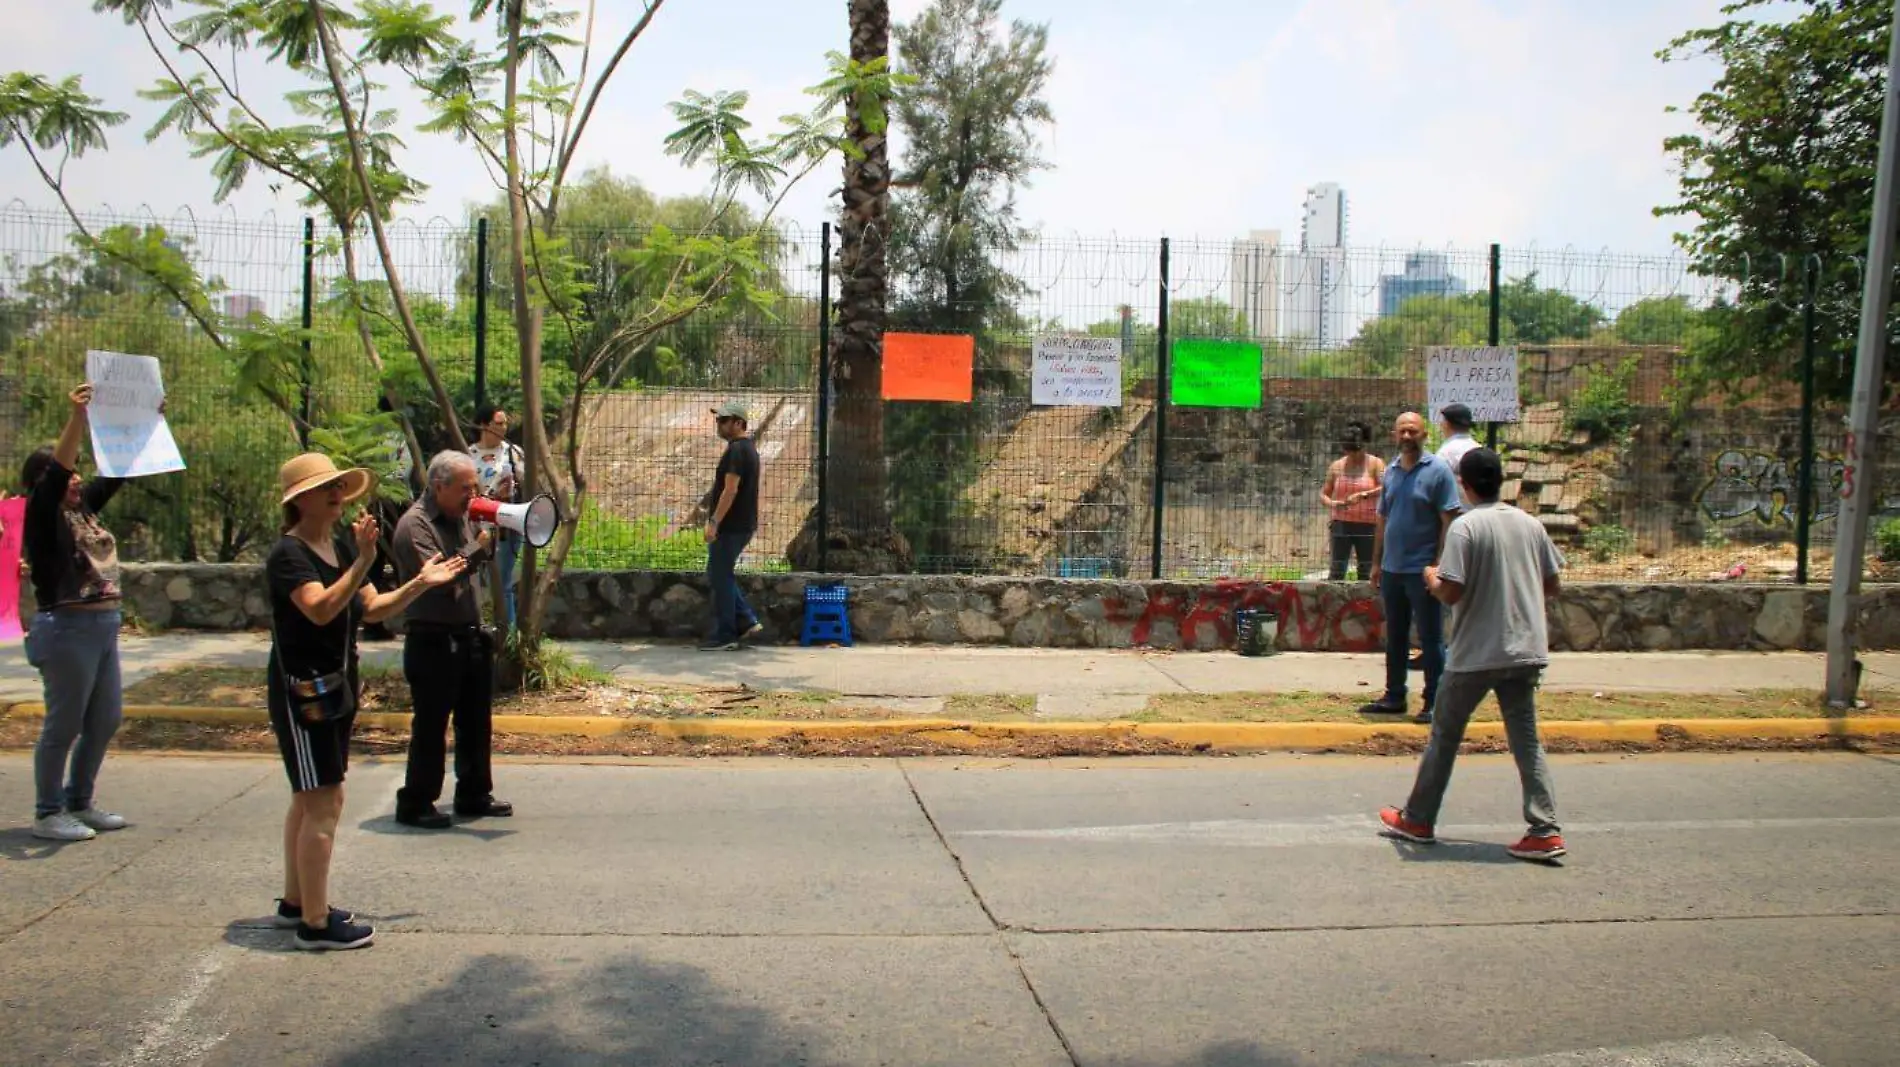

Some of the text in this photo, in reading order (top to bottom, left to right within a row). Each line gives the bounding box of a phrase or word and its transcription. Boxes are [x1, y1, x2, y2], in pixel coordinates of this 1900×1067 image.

[1443, 367, 1461, 383] LA
[1467, 367, 1513, 383] PRESA
[1430, 386, 1517, 403] NO QUEREMOS
